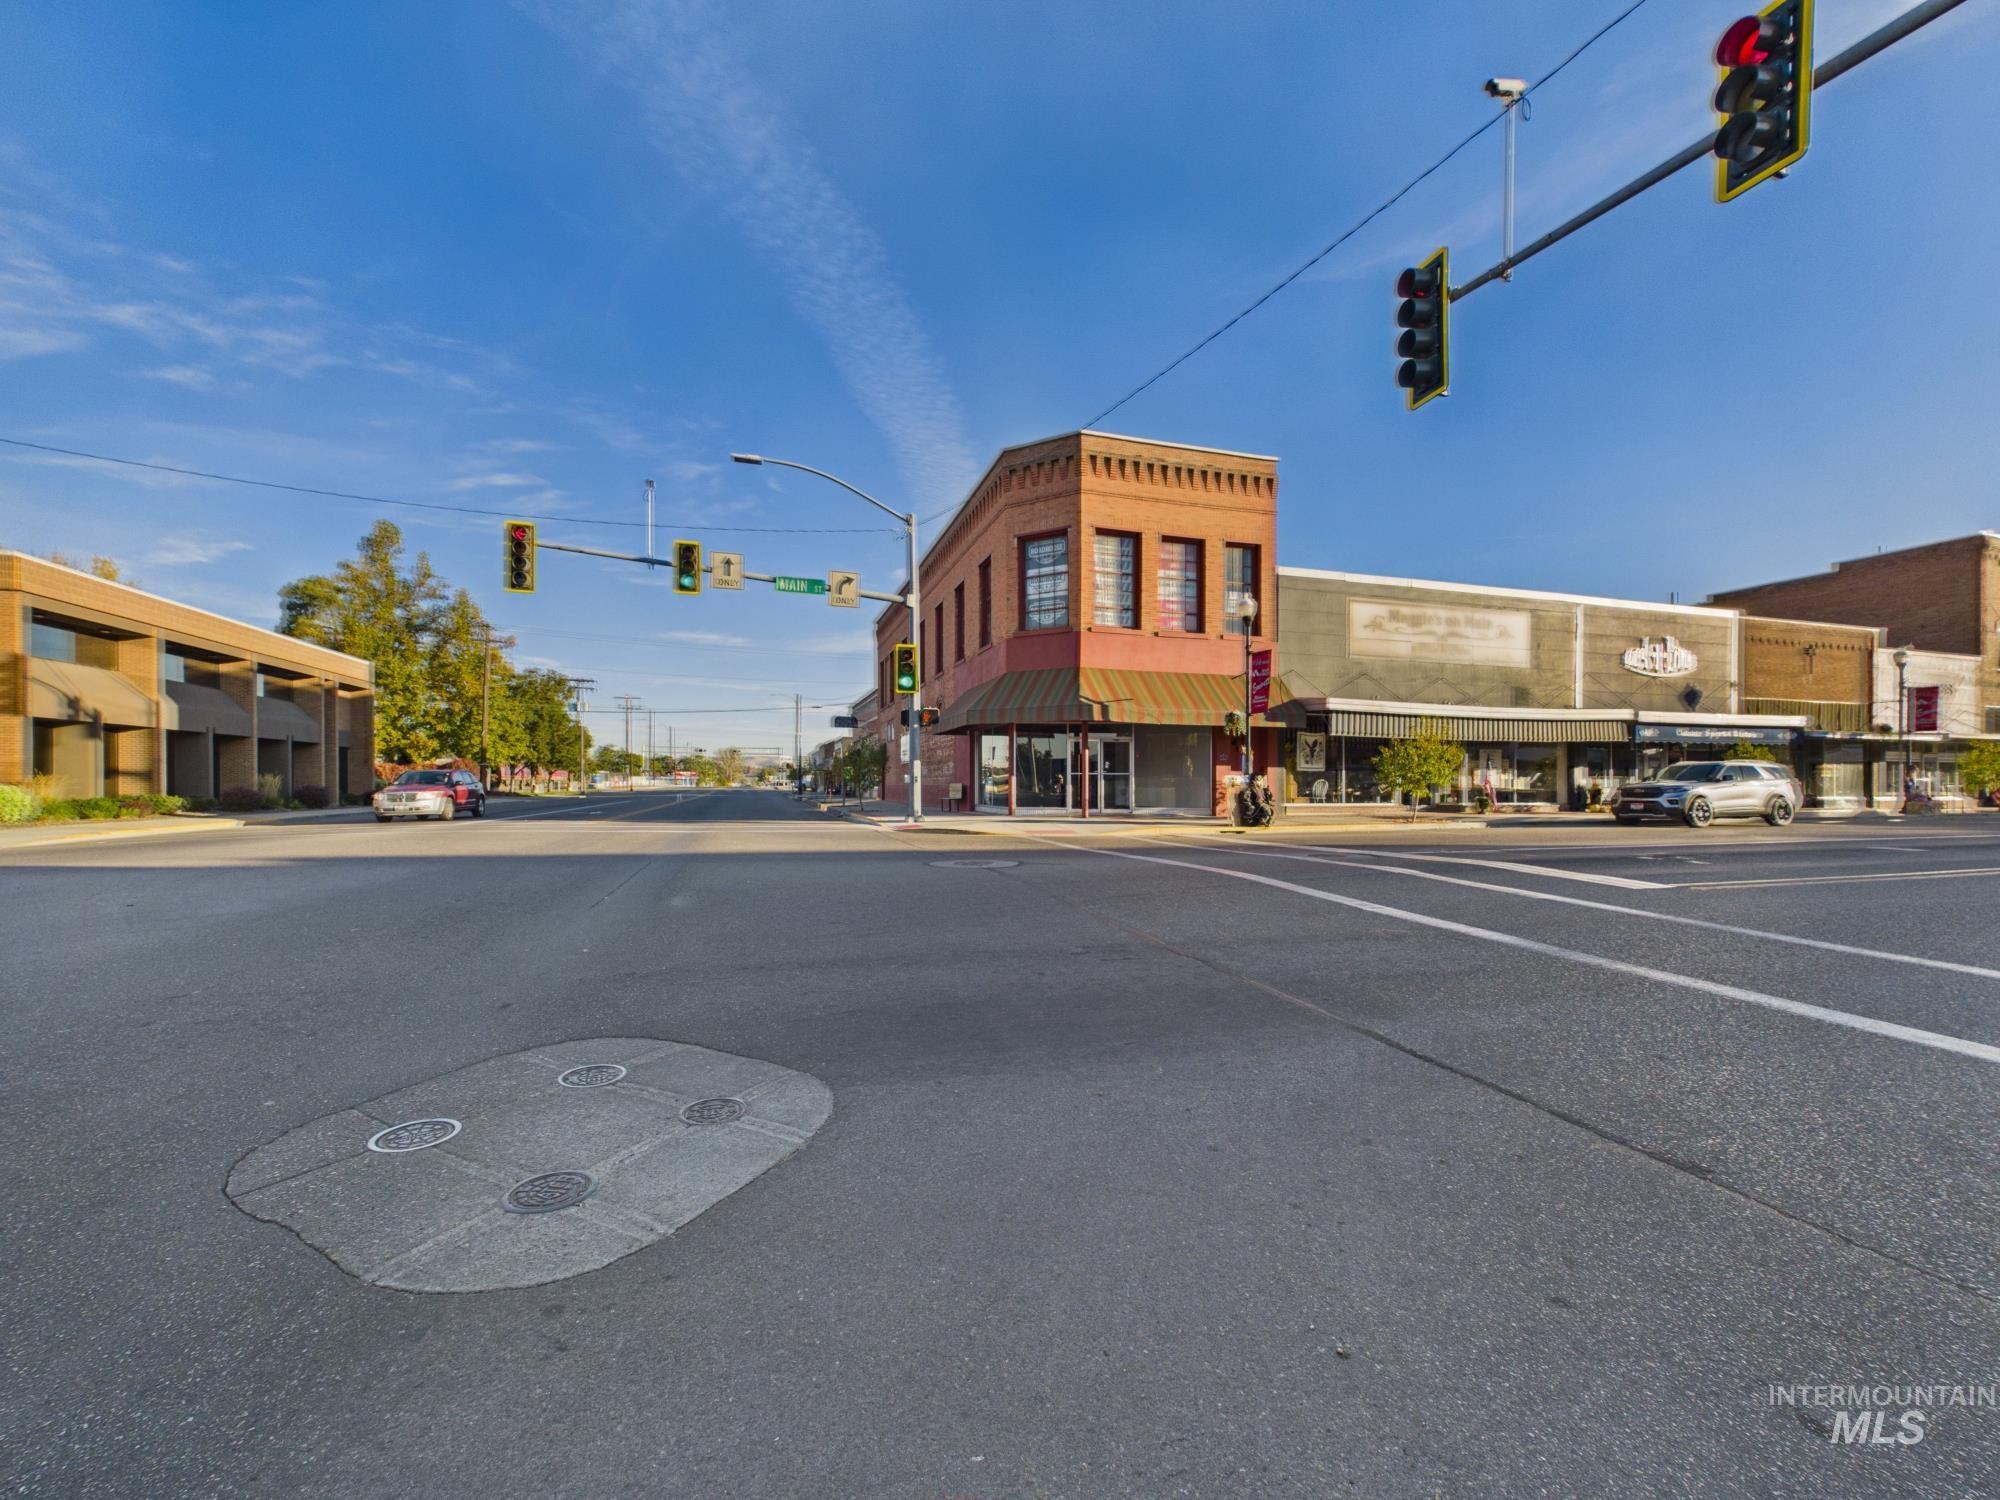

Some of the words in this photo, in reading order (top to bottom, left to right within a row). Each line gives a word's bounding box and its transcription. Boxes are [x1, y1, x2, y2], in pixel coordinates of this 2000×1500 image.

[717, 577, 739, 587] ONLY
[777, 577, 808, 592] MAIN
[834, 596, 856, 605] ONLY
